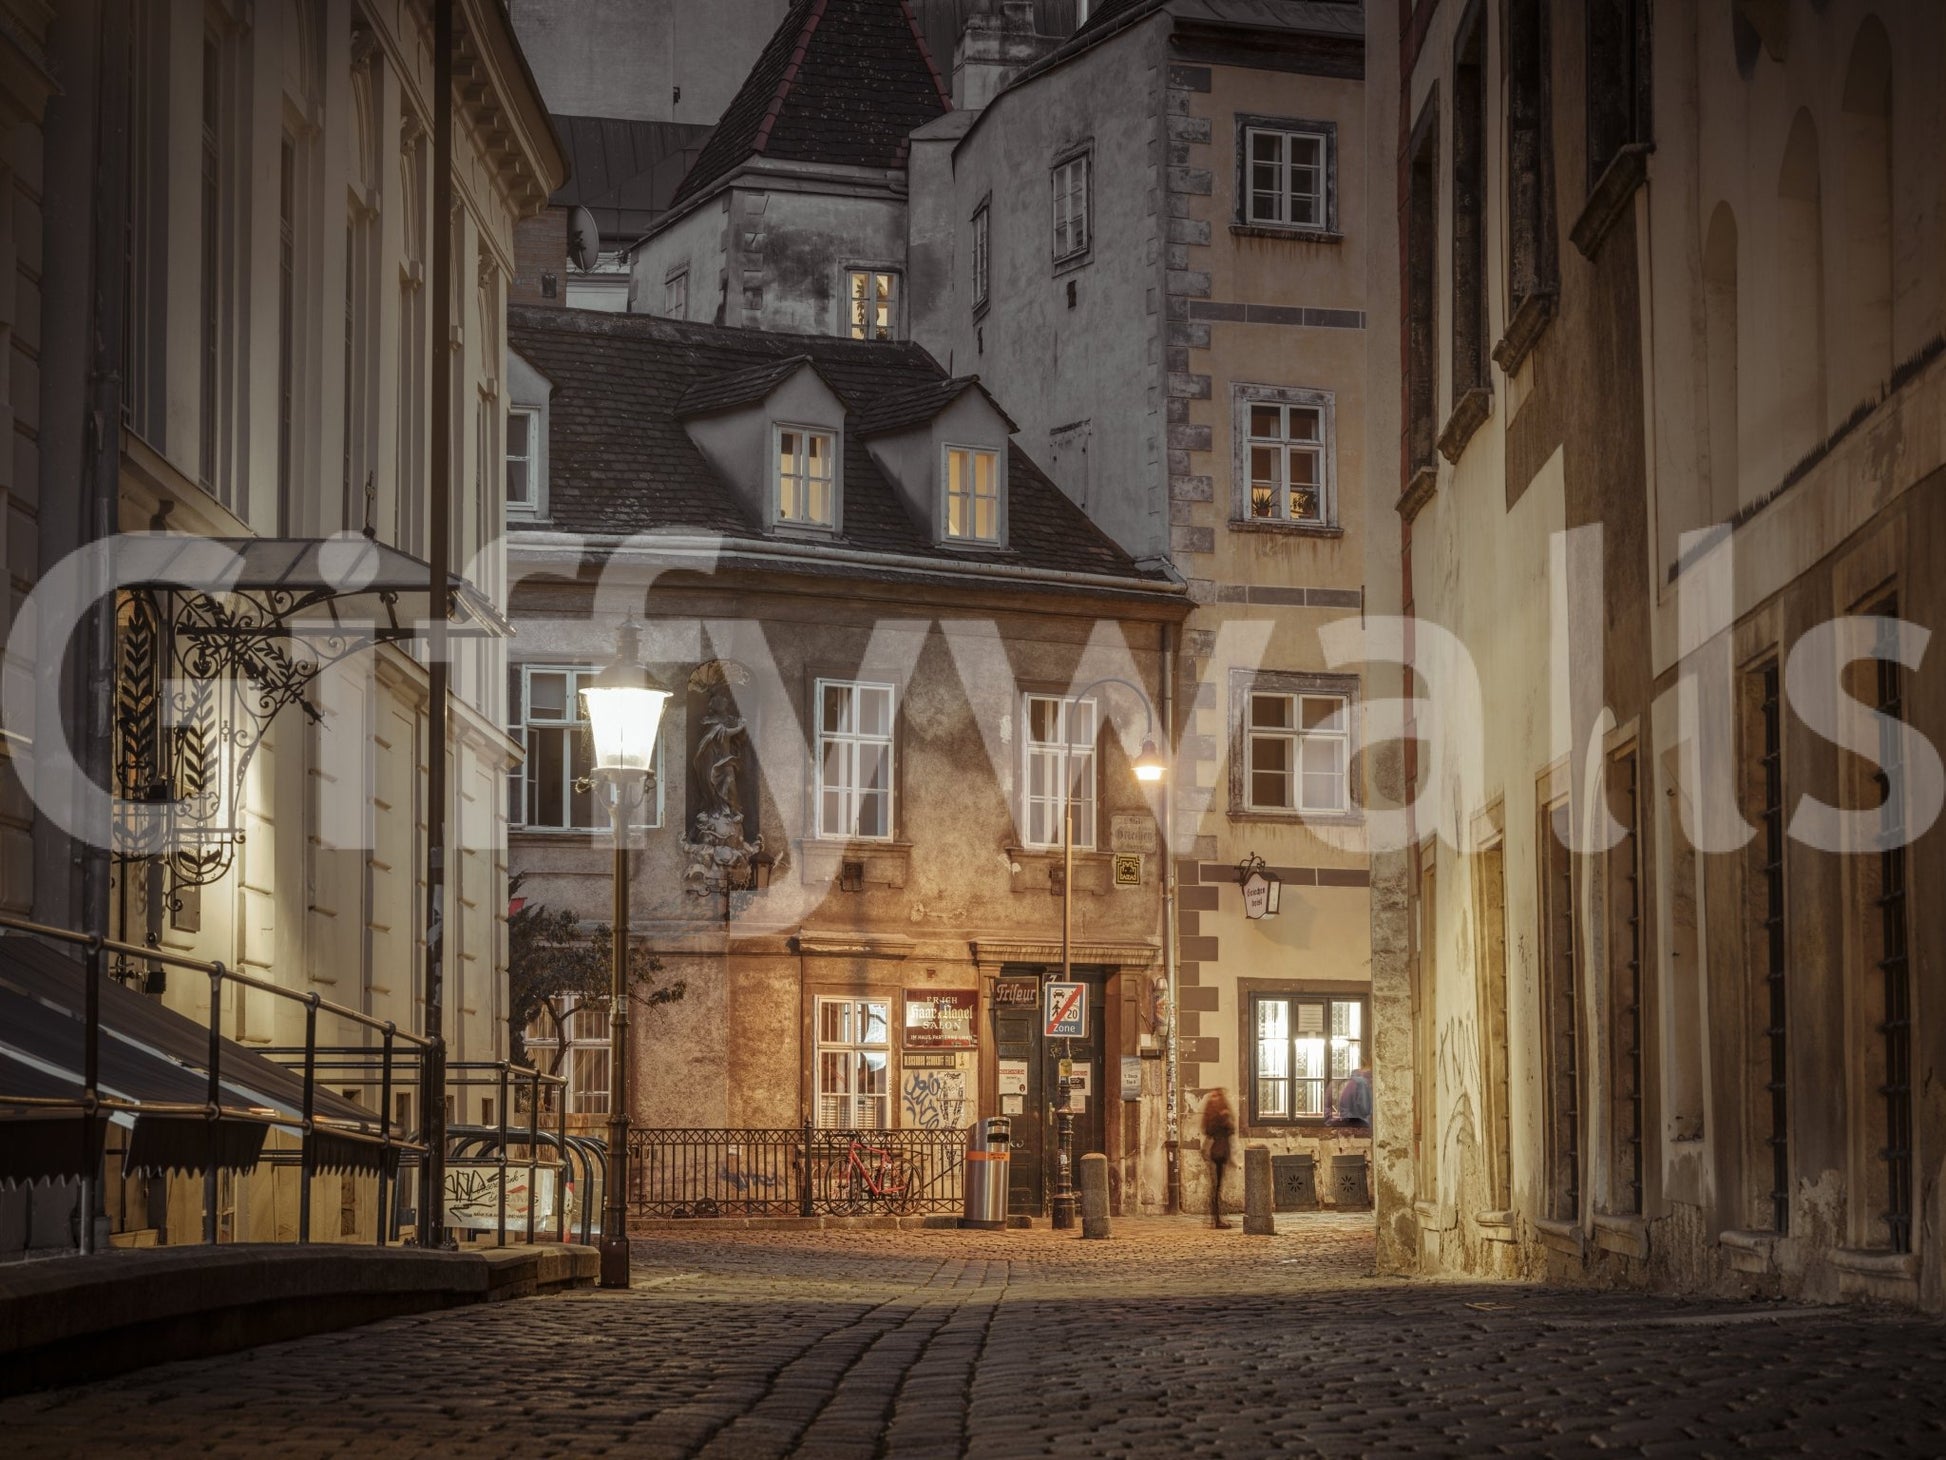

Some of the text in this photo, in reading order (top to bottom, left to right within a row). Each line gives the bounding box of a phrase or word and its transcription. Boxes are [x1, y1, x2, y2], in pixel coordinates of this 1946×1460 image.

[926, 996, 958, 1004] ERICH
[911, 1004, 937, 1019] Haar
[943, 1004, 973, 1021] Nagel
[1067, 1009, 1078, 1019] 20
[923, 1021, 960, 1029] SALON
[1053, 1023, 1076, 1032] Zone
